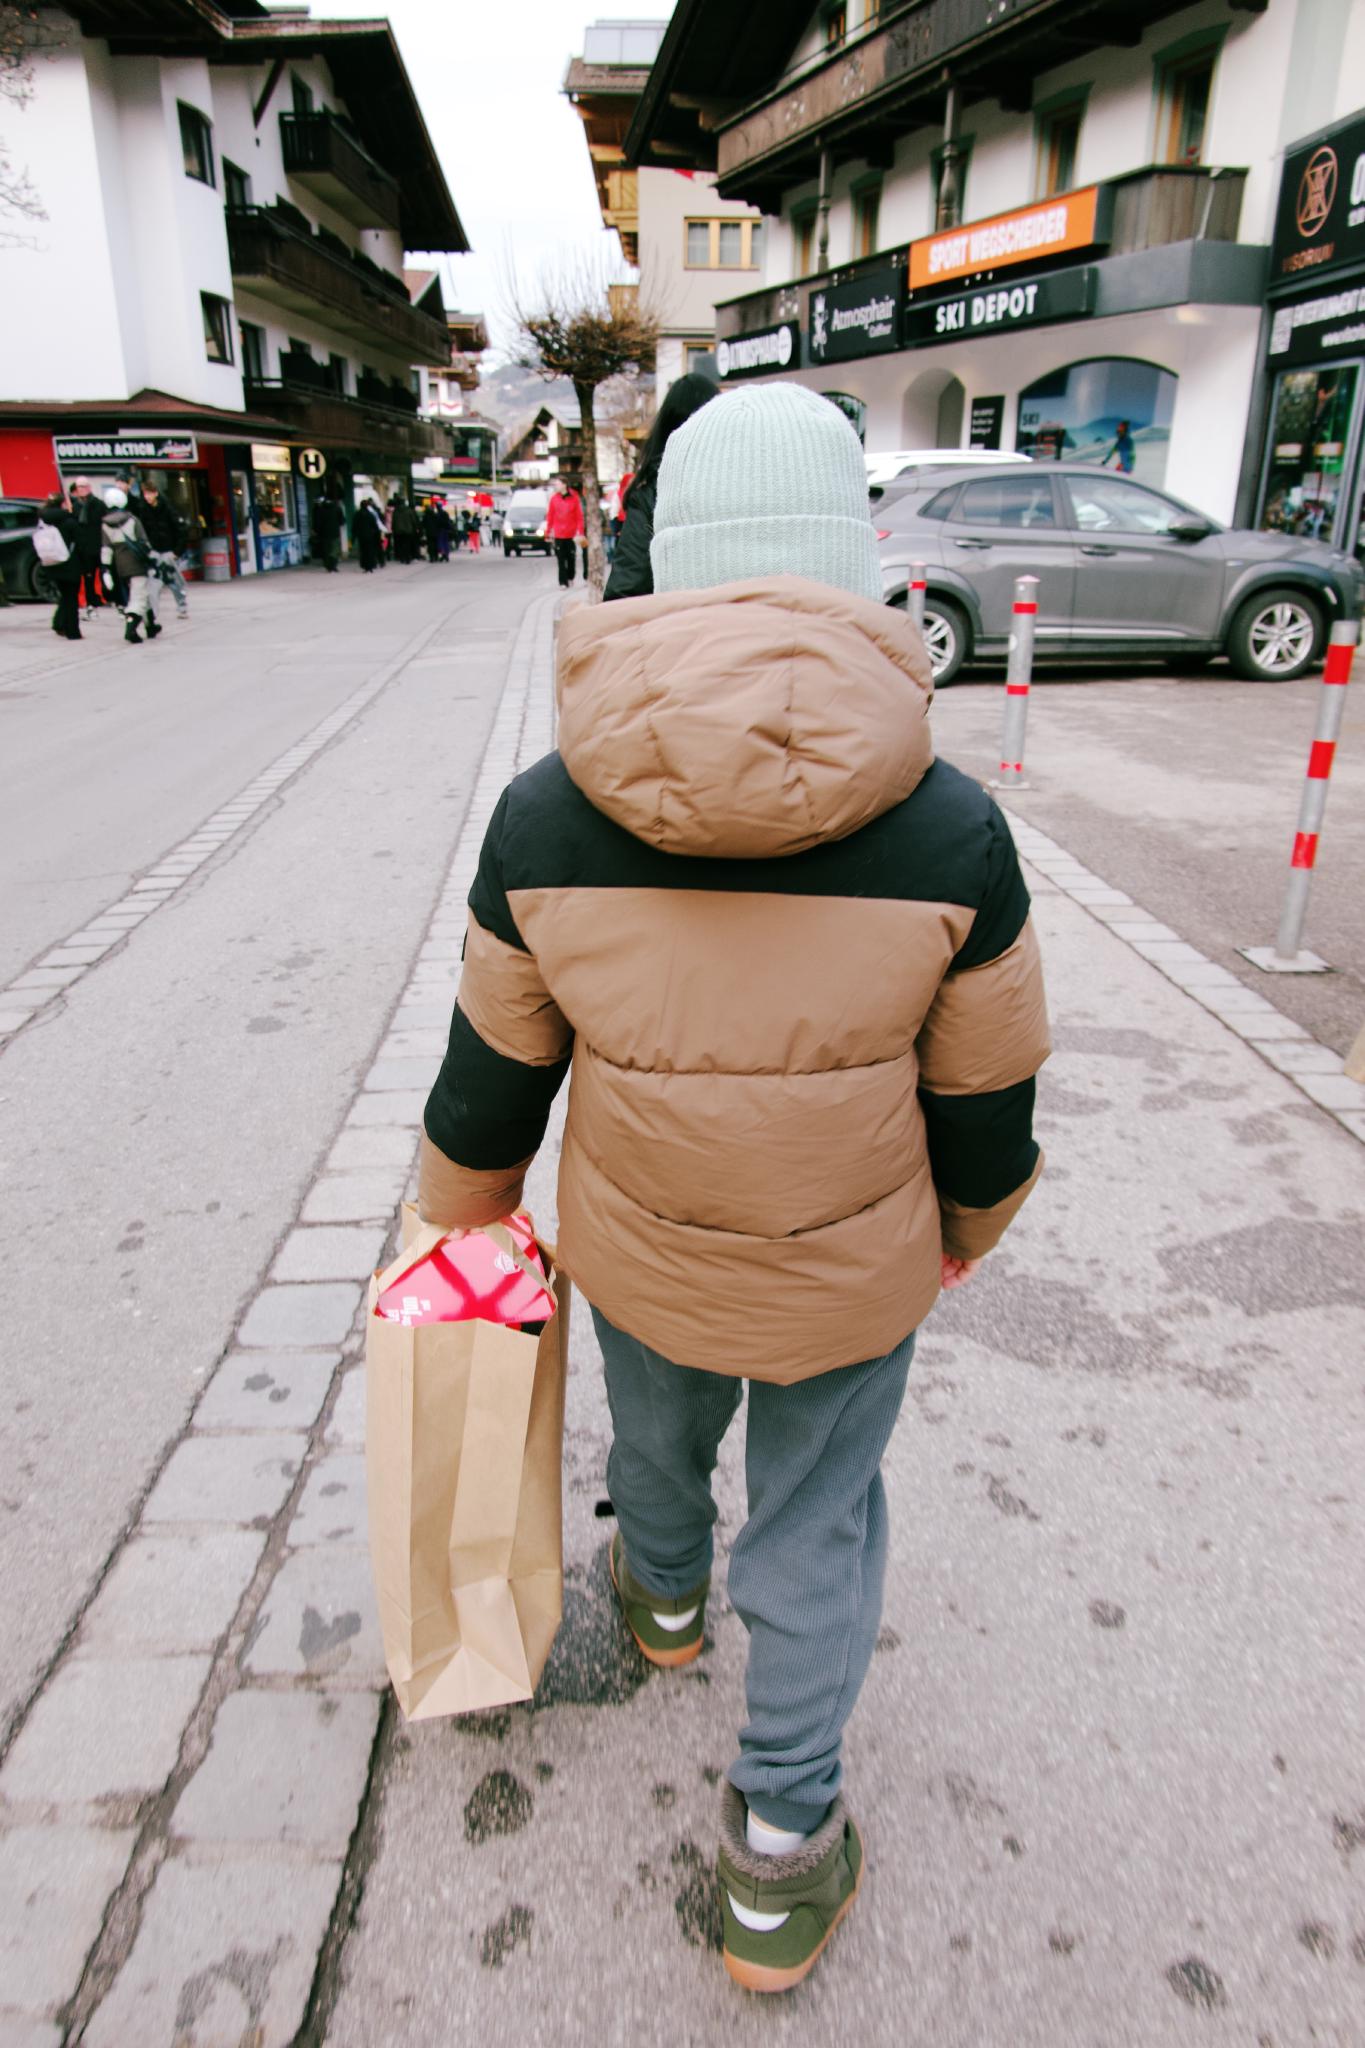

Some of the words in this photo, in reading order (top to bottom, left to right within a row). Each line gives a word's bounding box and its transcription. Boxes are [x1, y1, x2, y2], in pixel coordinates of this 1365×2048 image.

[928, 235, 969, 274] SPORT
[970, 205, 1067, 263] WEGSCHEIDER
[831, 295, 896, 332] Atmosphair
[935, 301, 966, 333] SKI
[971, 284, 1038, 326] DEPOT
[58, 443, 112, 457] OUTDOOR
[114, 442, 155, 456] ACTION
[304, 453, 320, 473] H
